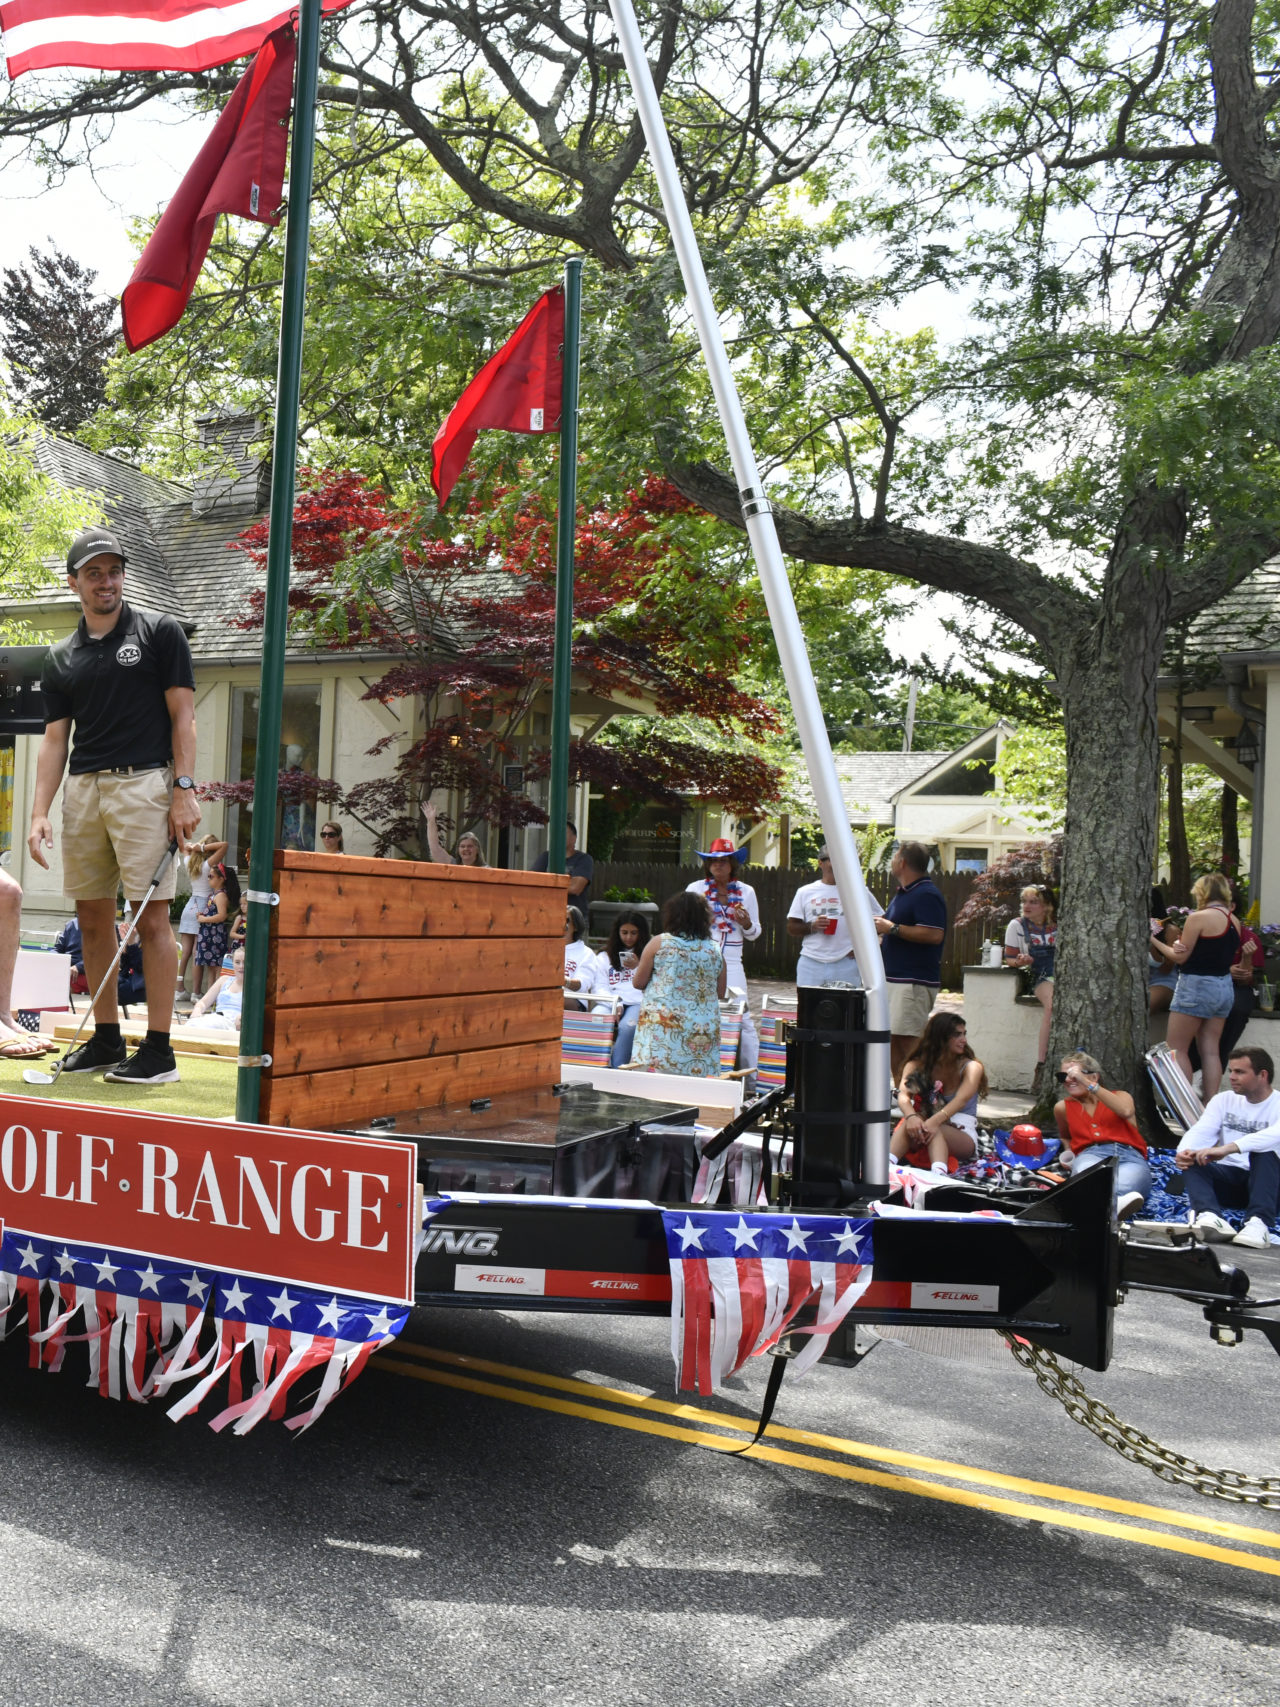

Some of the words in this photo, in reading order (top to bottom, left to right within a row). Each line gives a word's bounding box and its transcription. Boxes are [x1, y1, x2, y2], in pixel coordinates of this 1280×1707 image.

[136, 1141, 390, 1253] RANGE
[420, 1230, 500, 1256] ING
[475, 1273, 525, 1285] FELLING
[588, 1279, 639, 1291] FELLING
[930, 1291, 979, 1301] FELLING
